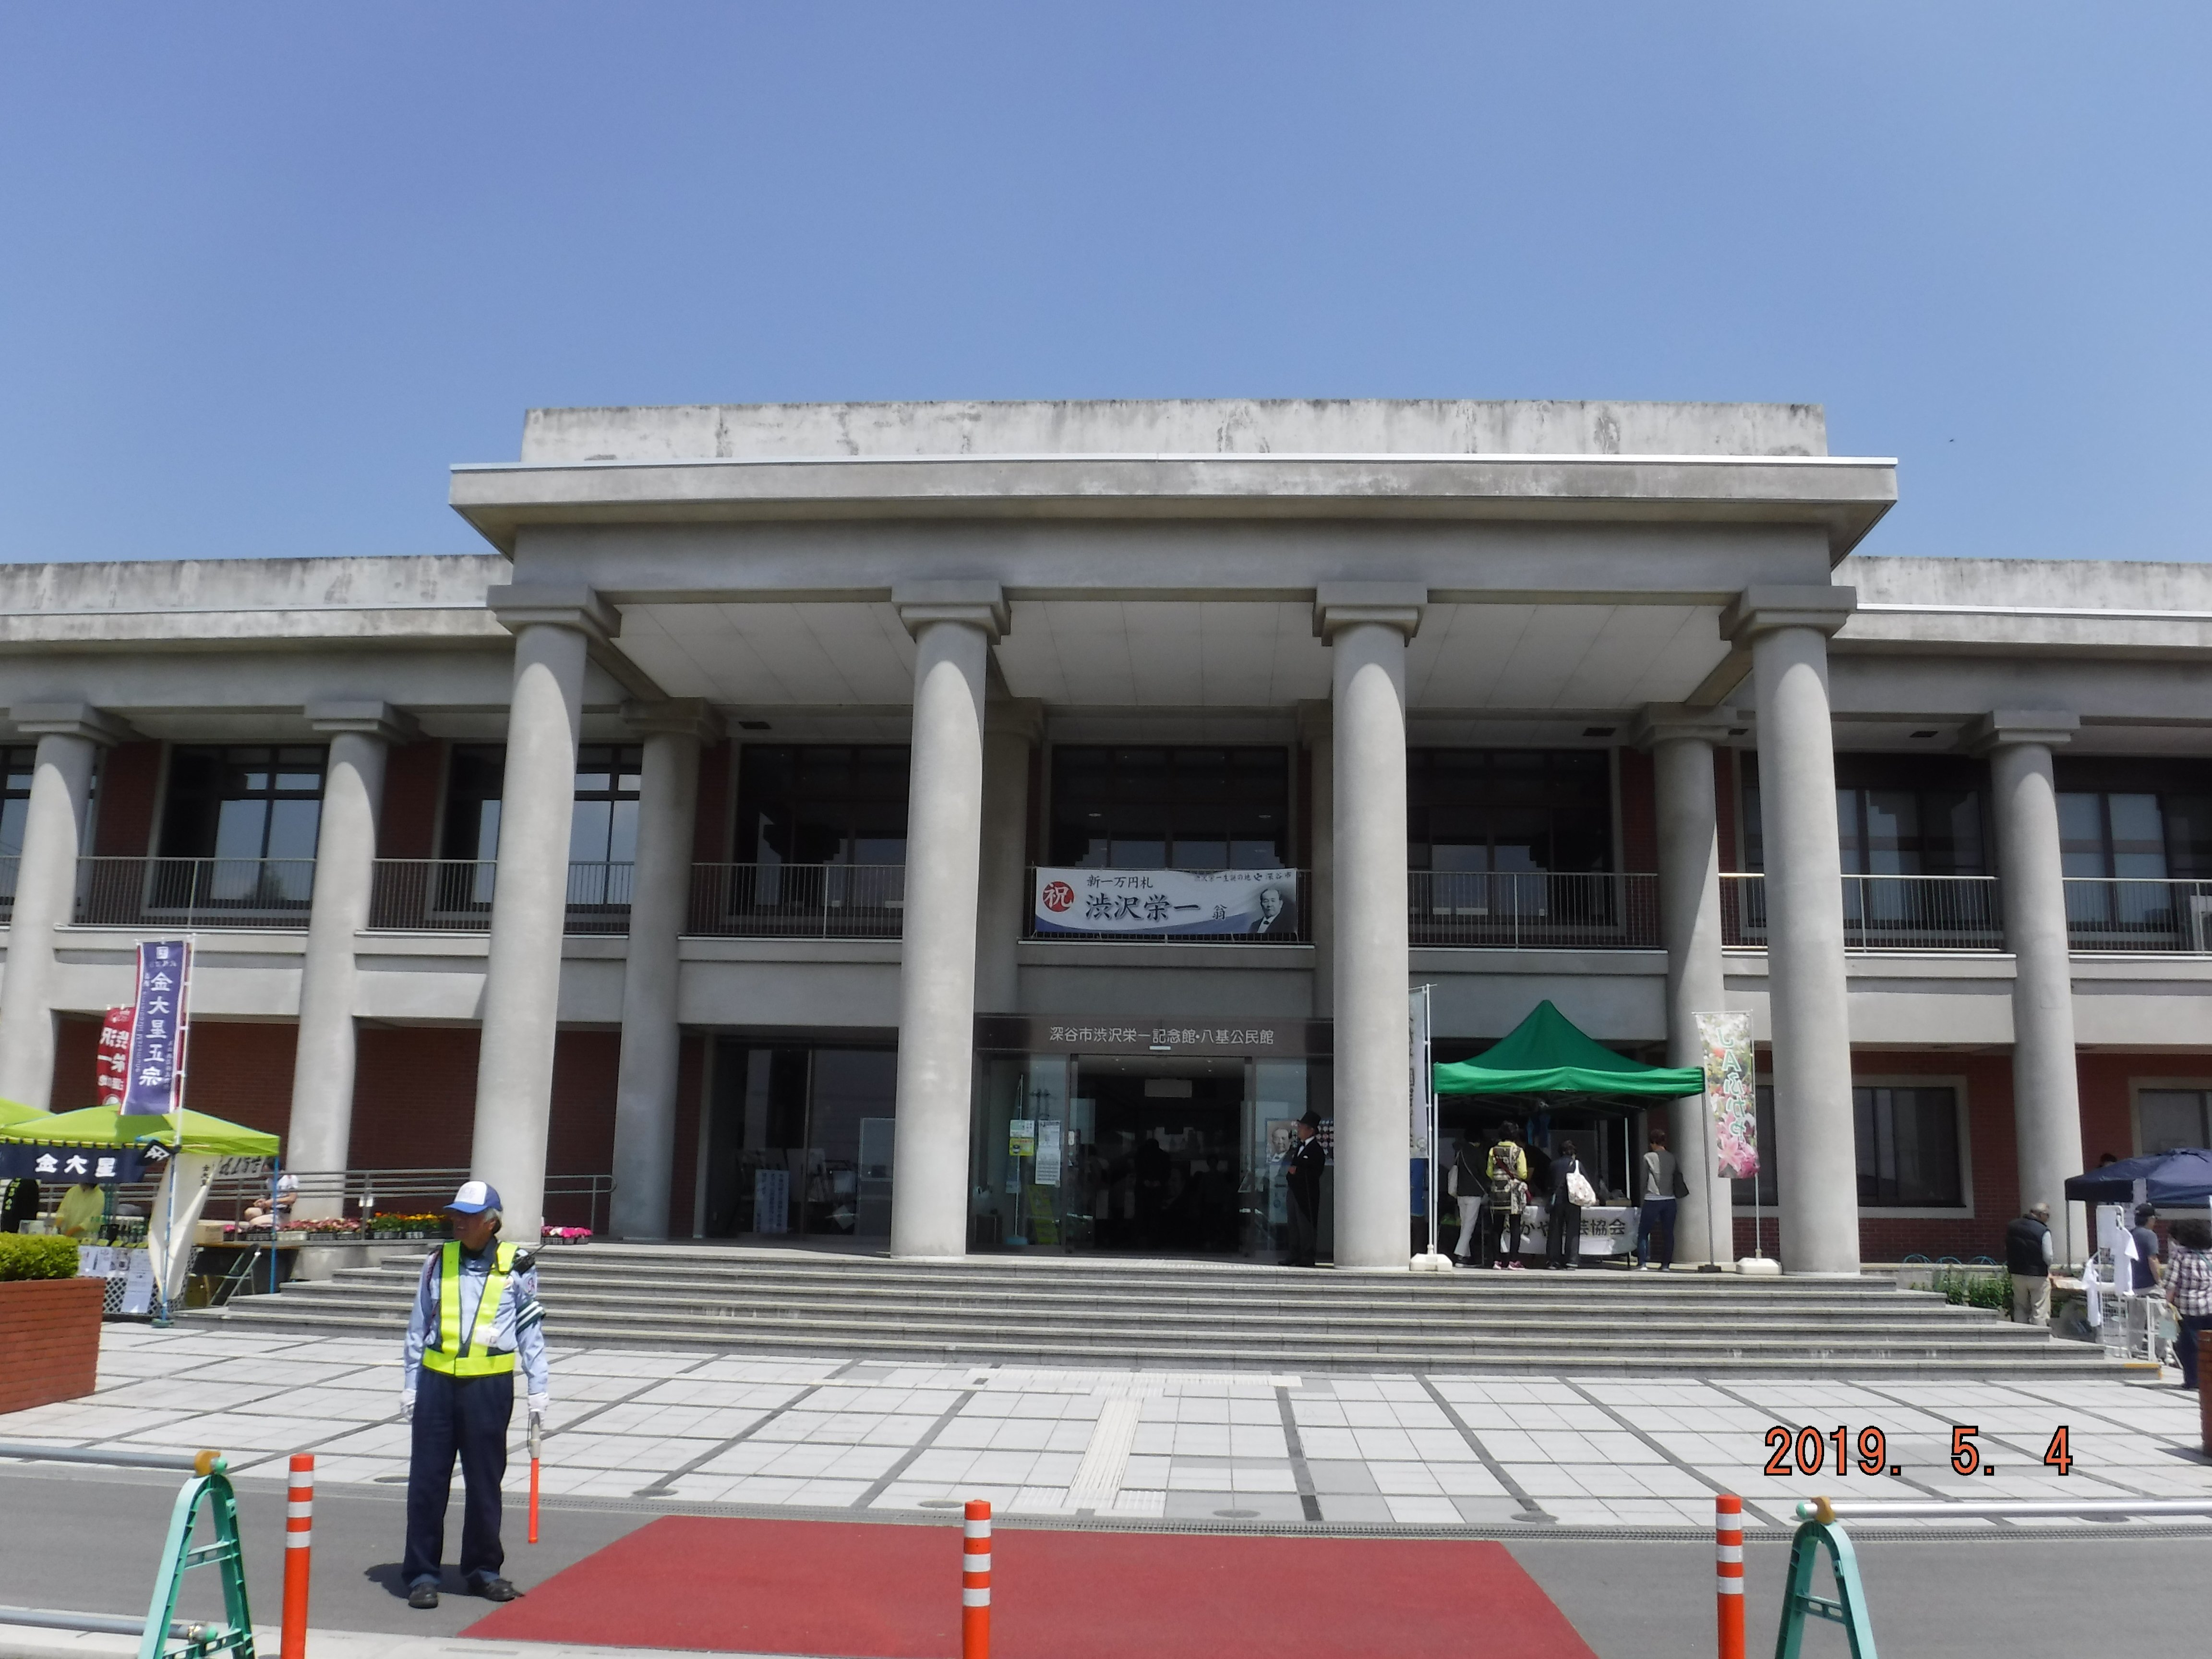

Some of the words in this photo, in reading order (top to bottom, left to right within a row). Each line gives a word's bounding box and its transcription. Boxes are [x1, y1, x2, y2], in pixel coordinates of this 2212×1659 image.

[1086, 875, 1153, 889] 新一万円札
[1044, 883, 1073, 909] 祝
[1085, 893, 1201, 921] 渋沢栄一
[1211, 904, 1228, 921] 翁
[1049, 1026, 1274, 1045] 深谷市渋沢栄一記念館・八基公民館
[34, 1153, 116, 1178] 金大星
